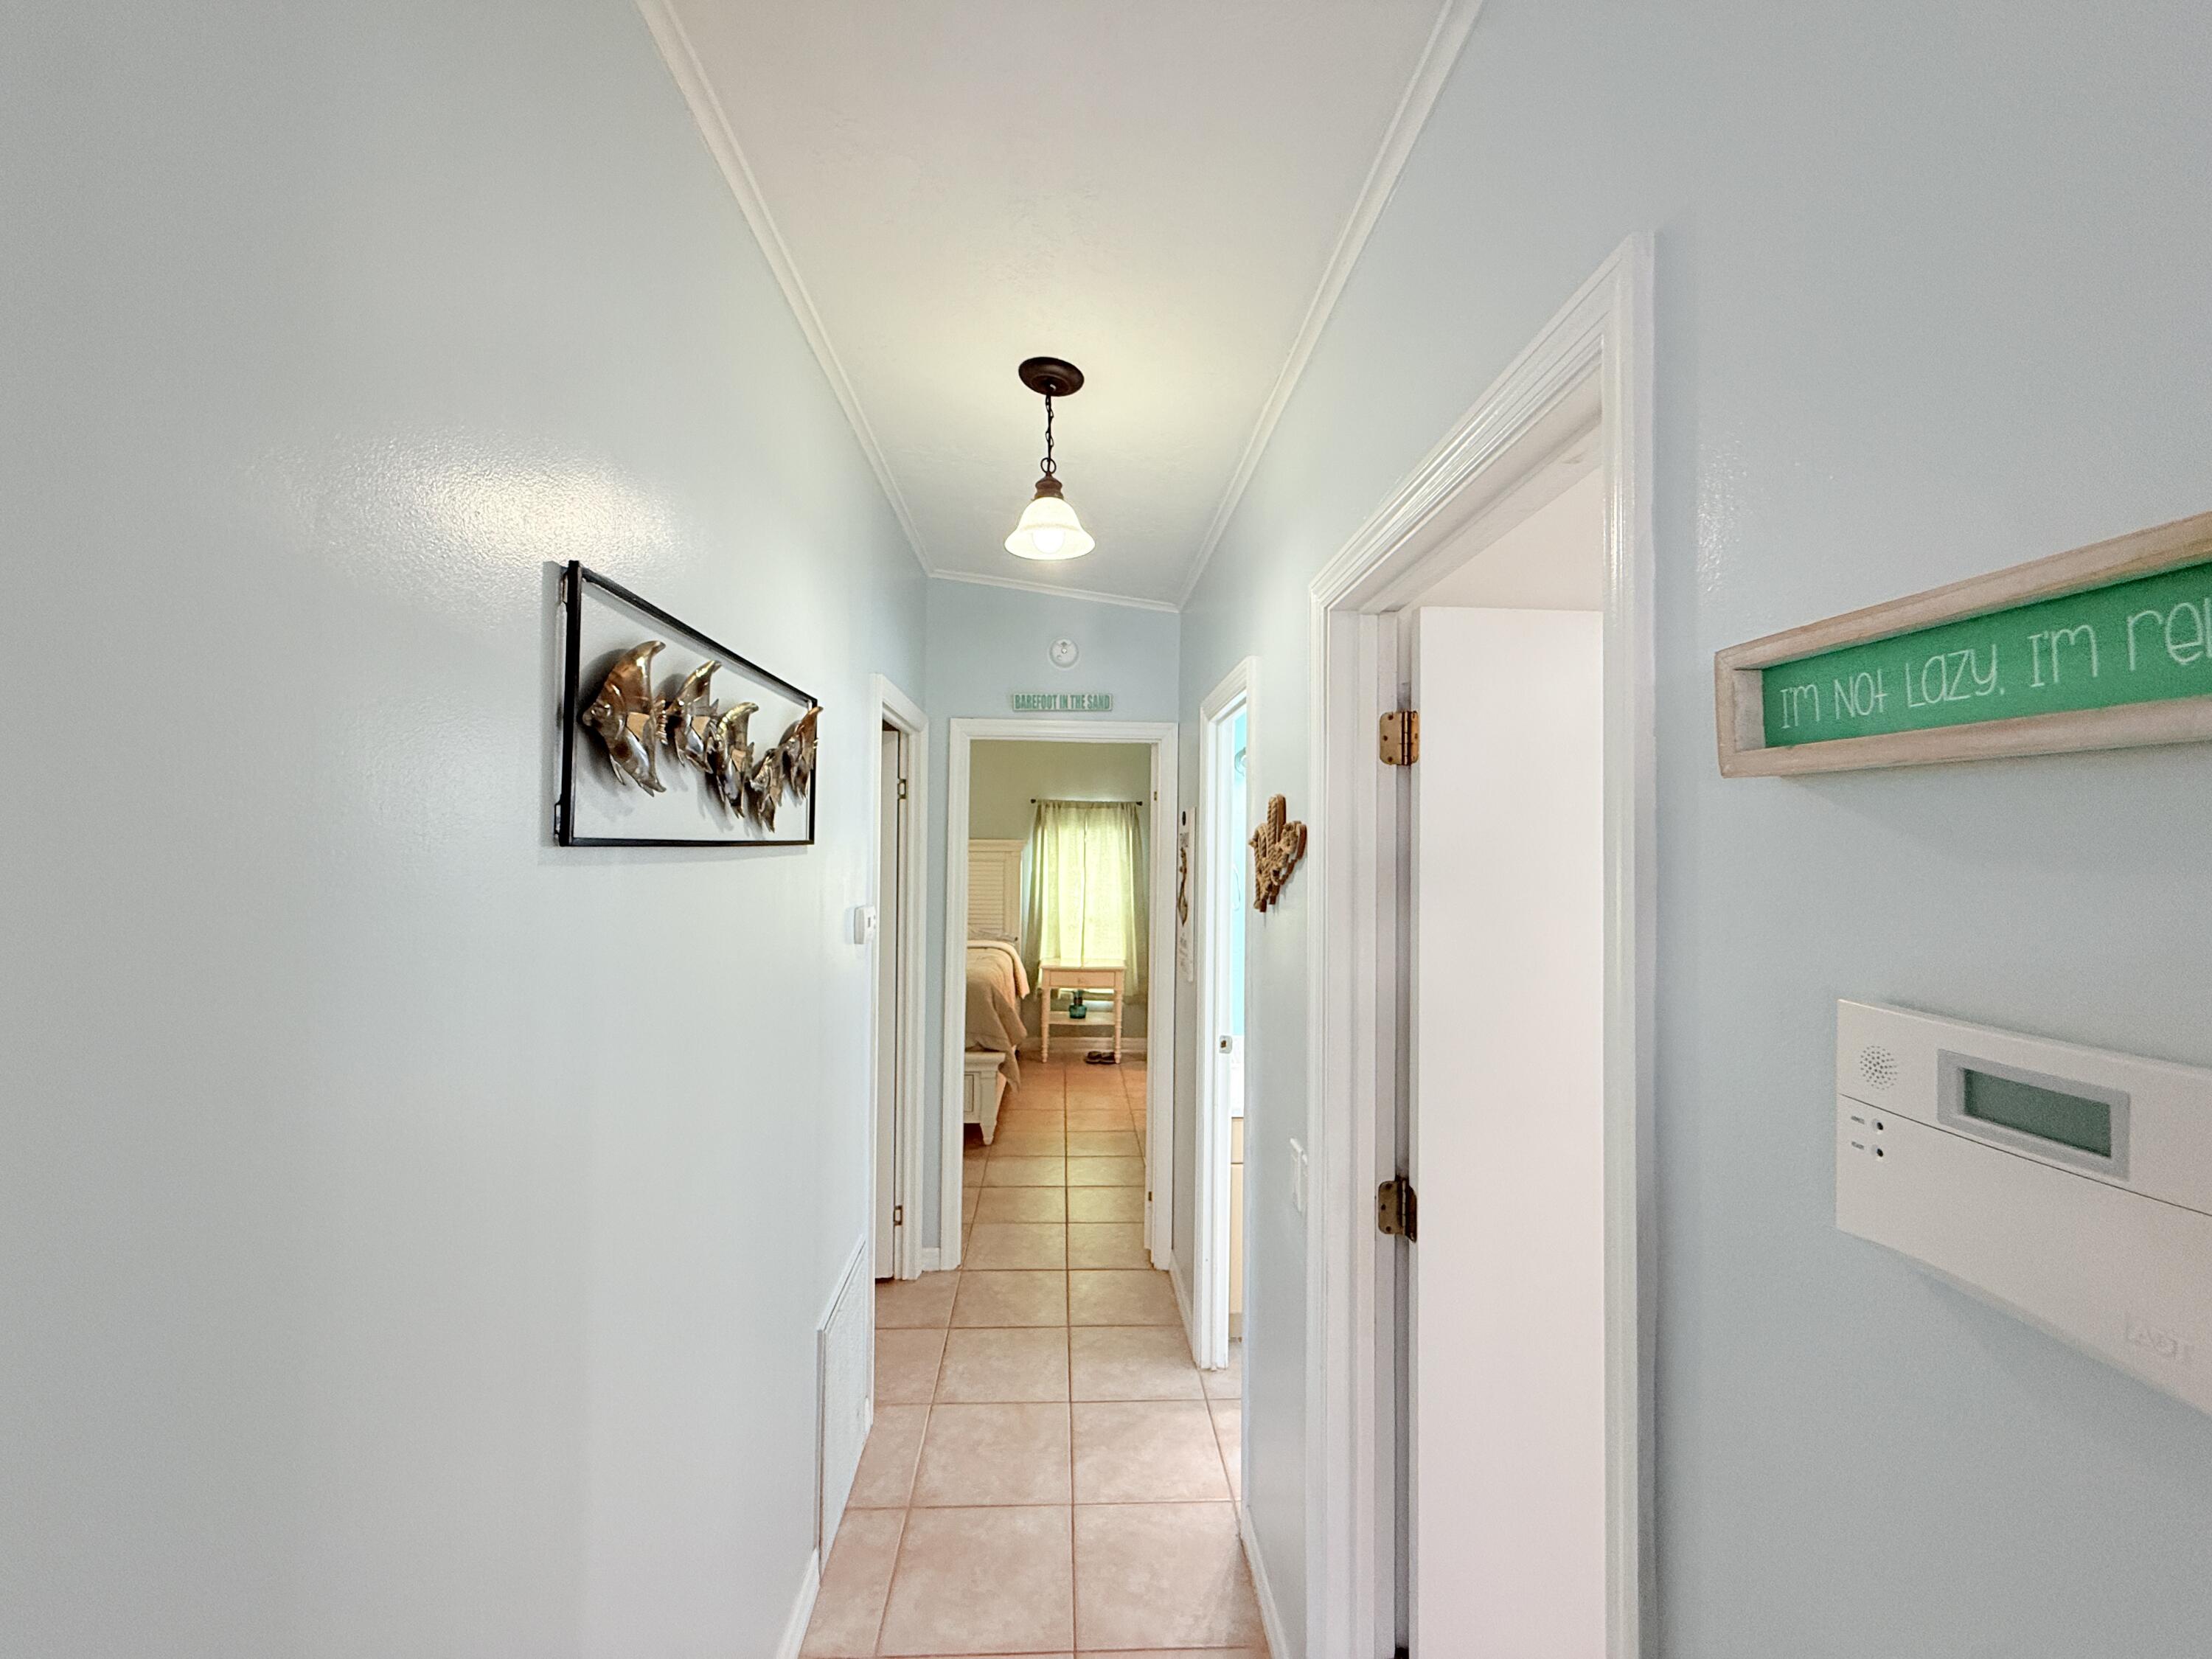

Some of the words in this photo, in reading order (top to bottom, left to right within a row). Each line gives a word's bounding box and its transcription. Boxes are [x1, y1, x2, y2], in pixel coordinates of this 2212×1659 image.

[1014, 694, 1057, 709] BAREFOOT
[1059, 694, 1068, 709] IN
[1069, 694, 1086, 709] THE
[1087, 694, 1110, 709] SAND
